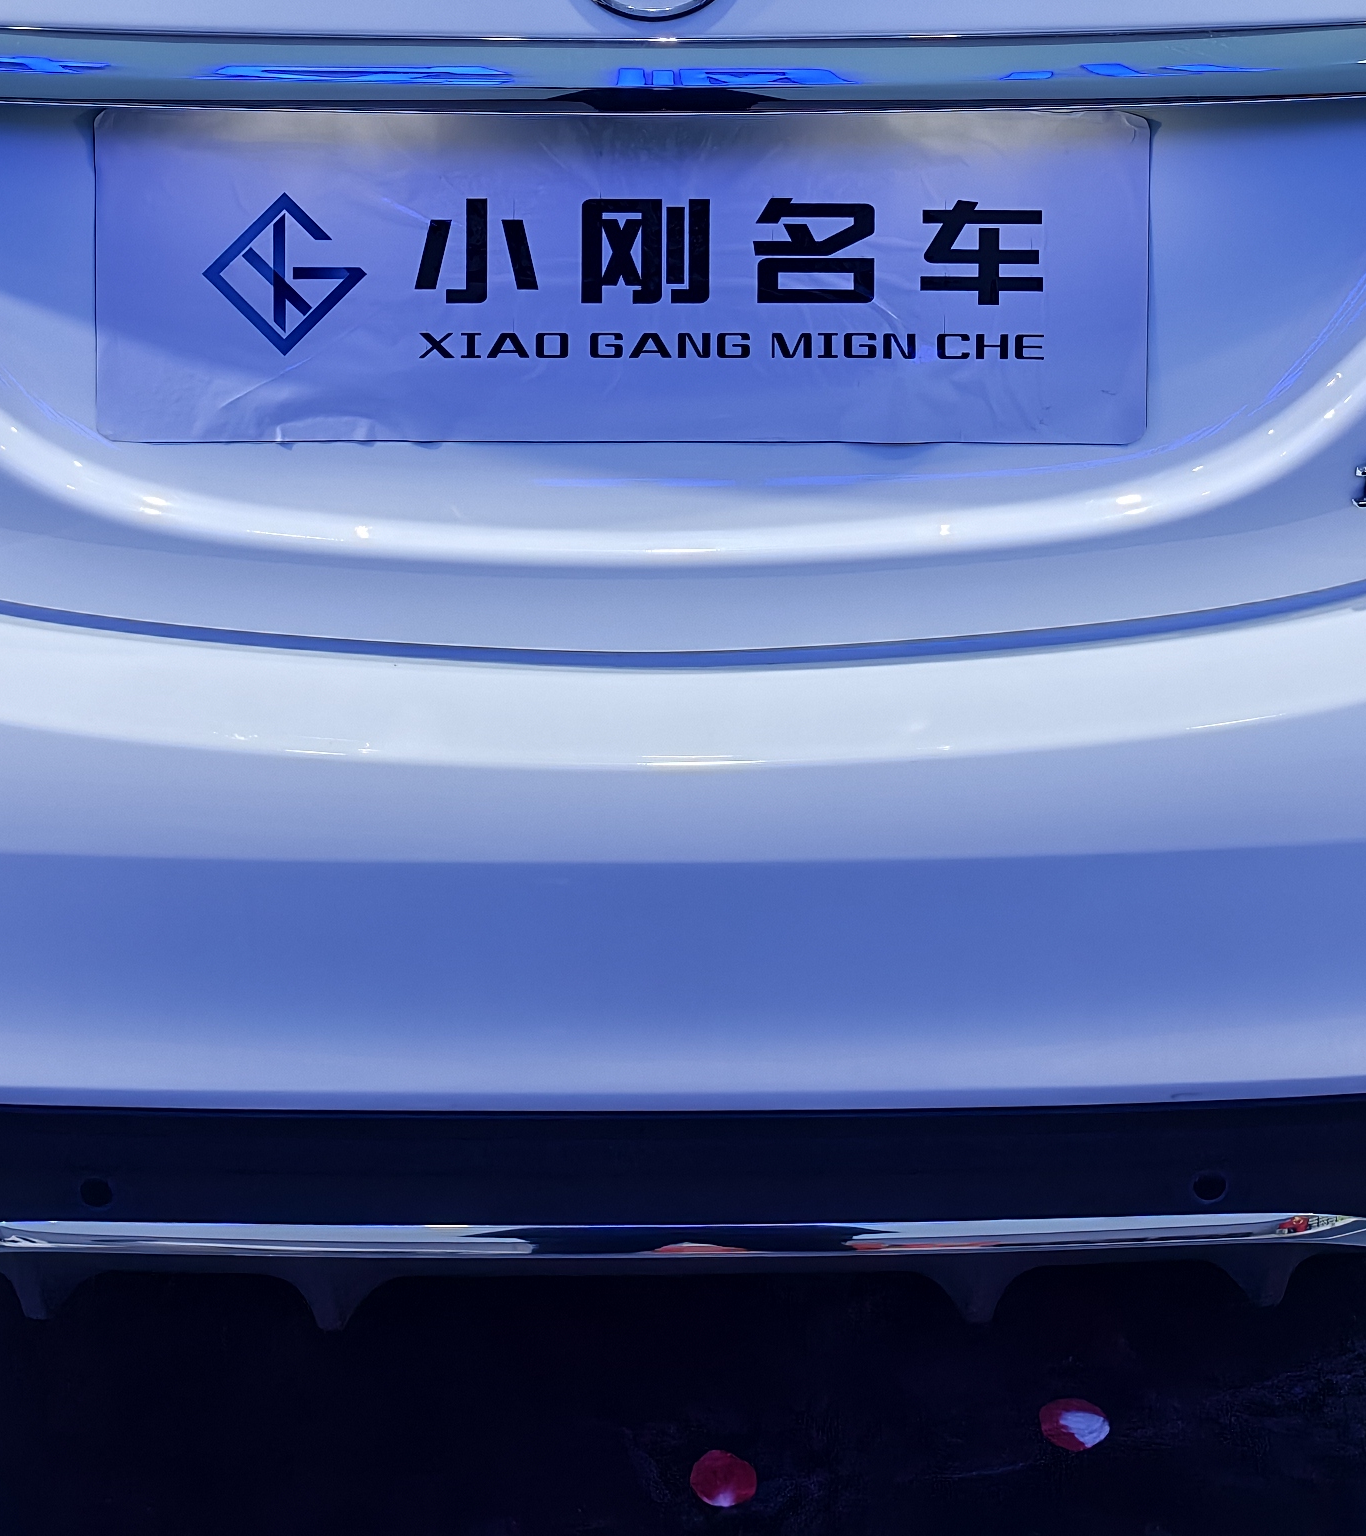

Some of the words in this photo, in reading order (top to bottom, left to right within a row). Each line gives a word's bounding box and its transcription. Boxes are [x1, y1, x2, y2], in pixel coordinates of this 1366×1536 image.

[414, 195, 1044, 306] 小刚名车
[418, 332, 571, 360] XIAO
[588, 332, 752, 360] GANG
[771, 332, 916, 360] MIGN
[936, 332, 1045, 361] CHE
